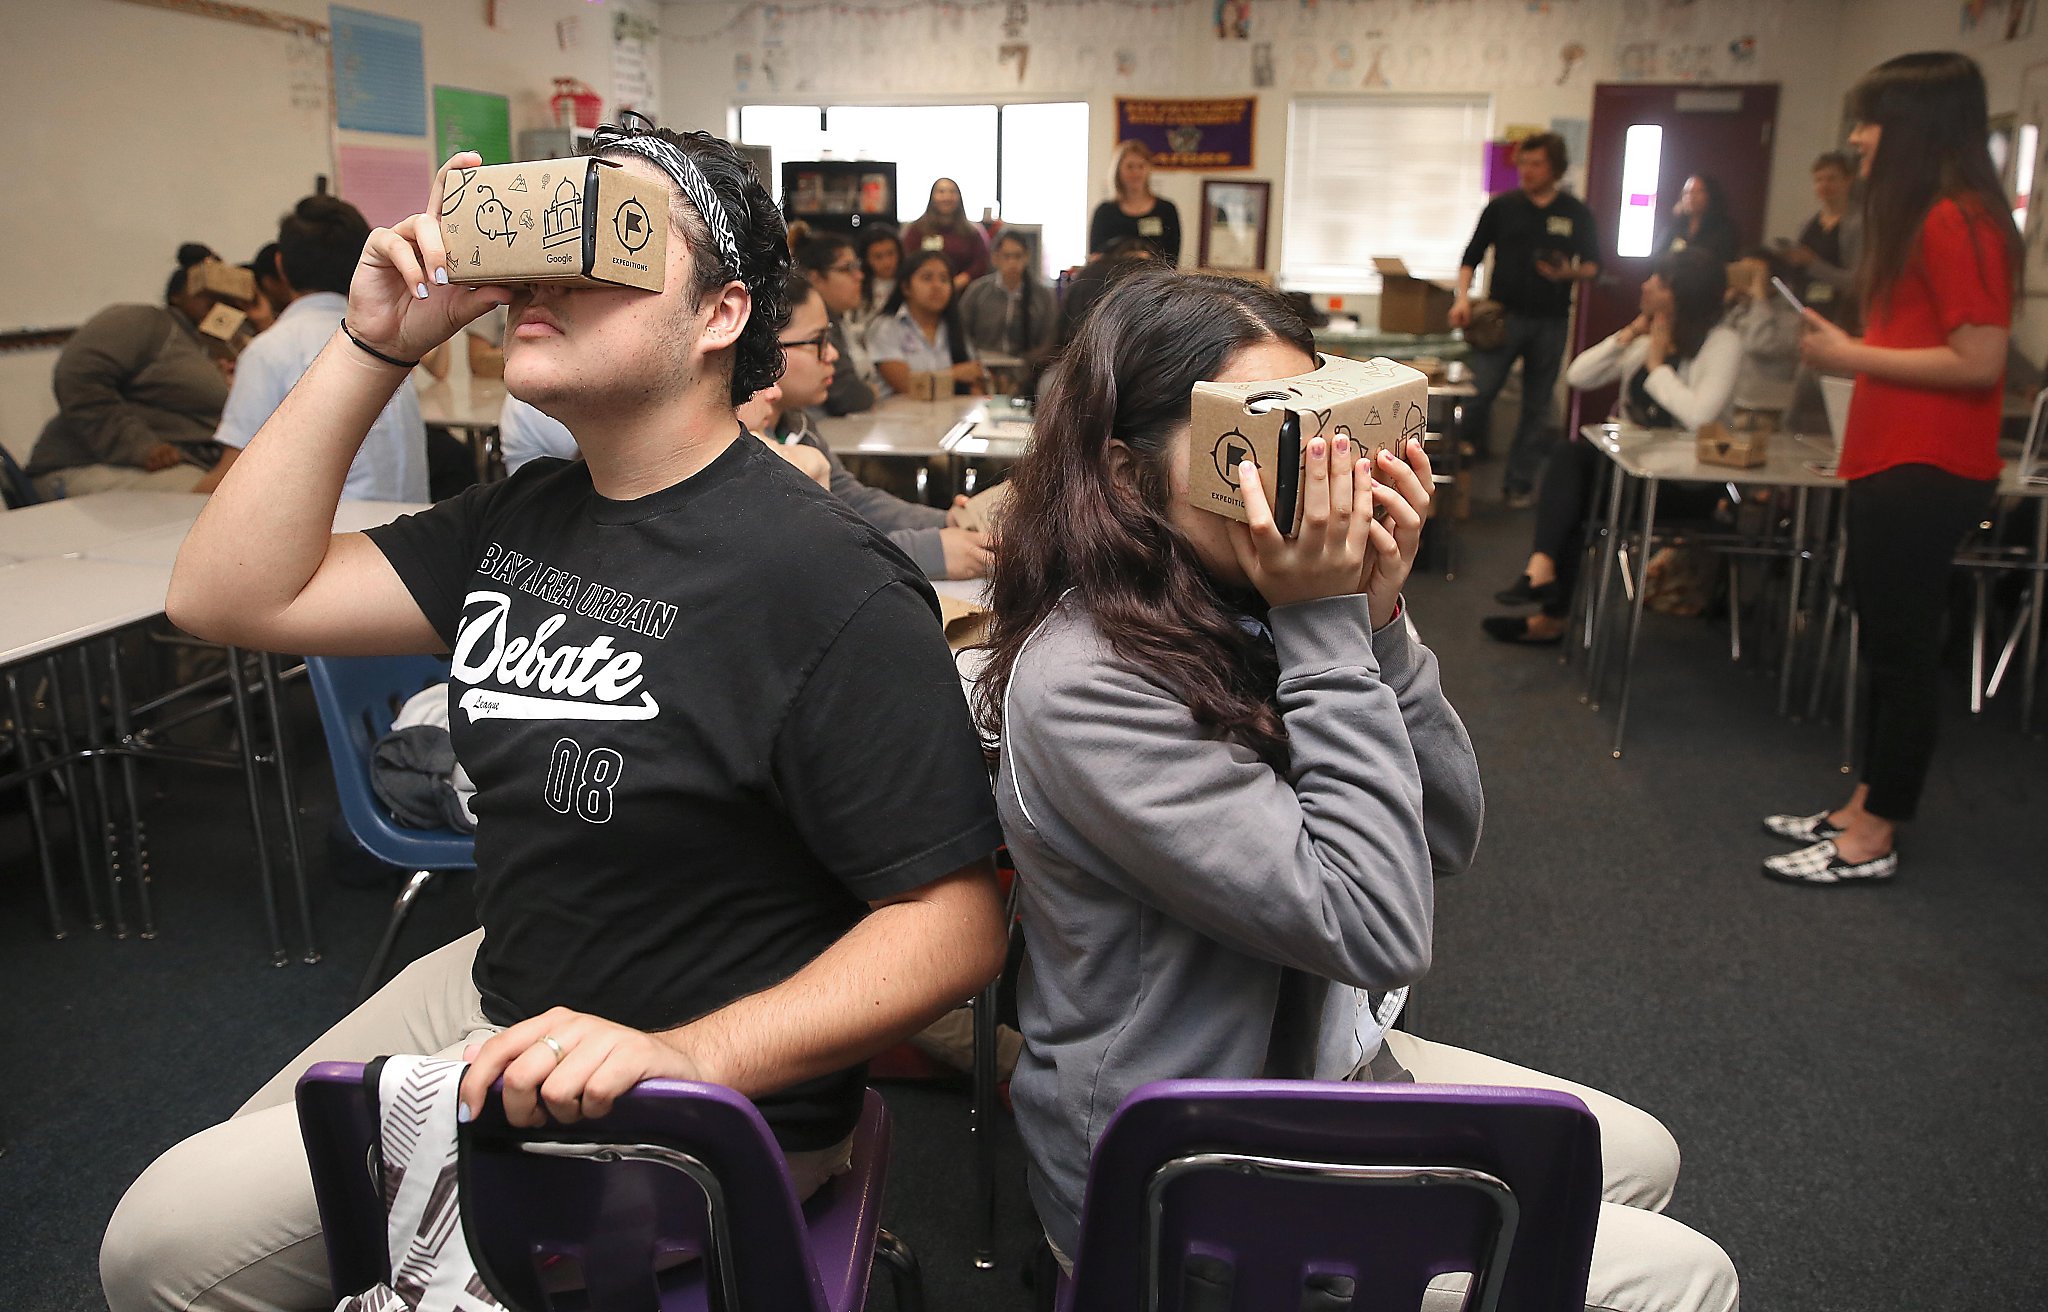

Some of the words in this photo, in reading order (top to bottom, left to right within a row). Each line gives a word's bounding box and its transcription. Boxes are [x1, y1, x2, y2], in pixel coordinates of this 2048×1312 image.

[546, 253, 573, 265] Google
[612, 257, 648, 272] EXPEDITIONS
[1211, 492, 1246, 508] EXPEDITIO
[477, 542, 534, 586] BAY
[519, 562, 581, 609] AREA
[575, 582, 679, 640] URBAN
[450, 590, 644, 702] Debate
[472, 695, 500, 714] League
[544, 737, 624, 824] 08
